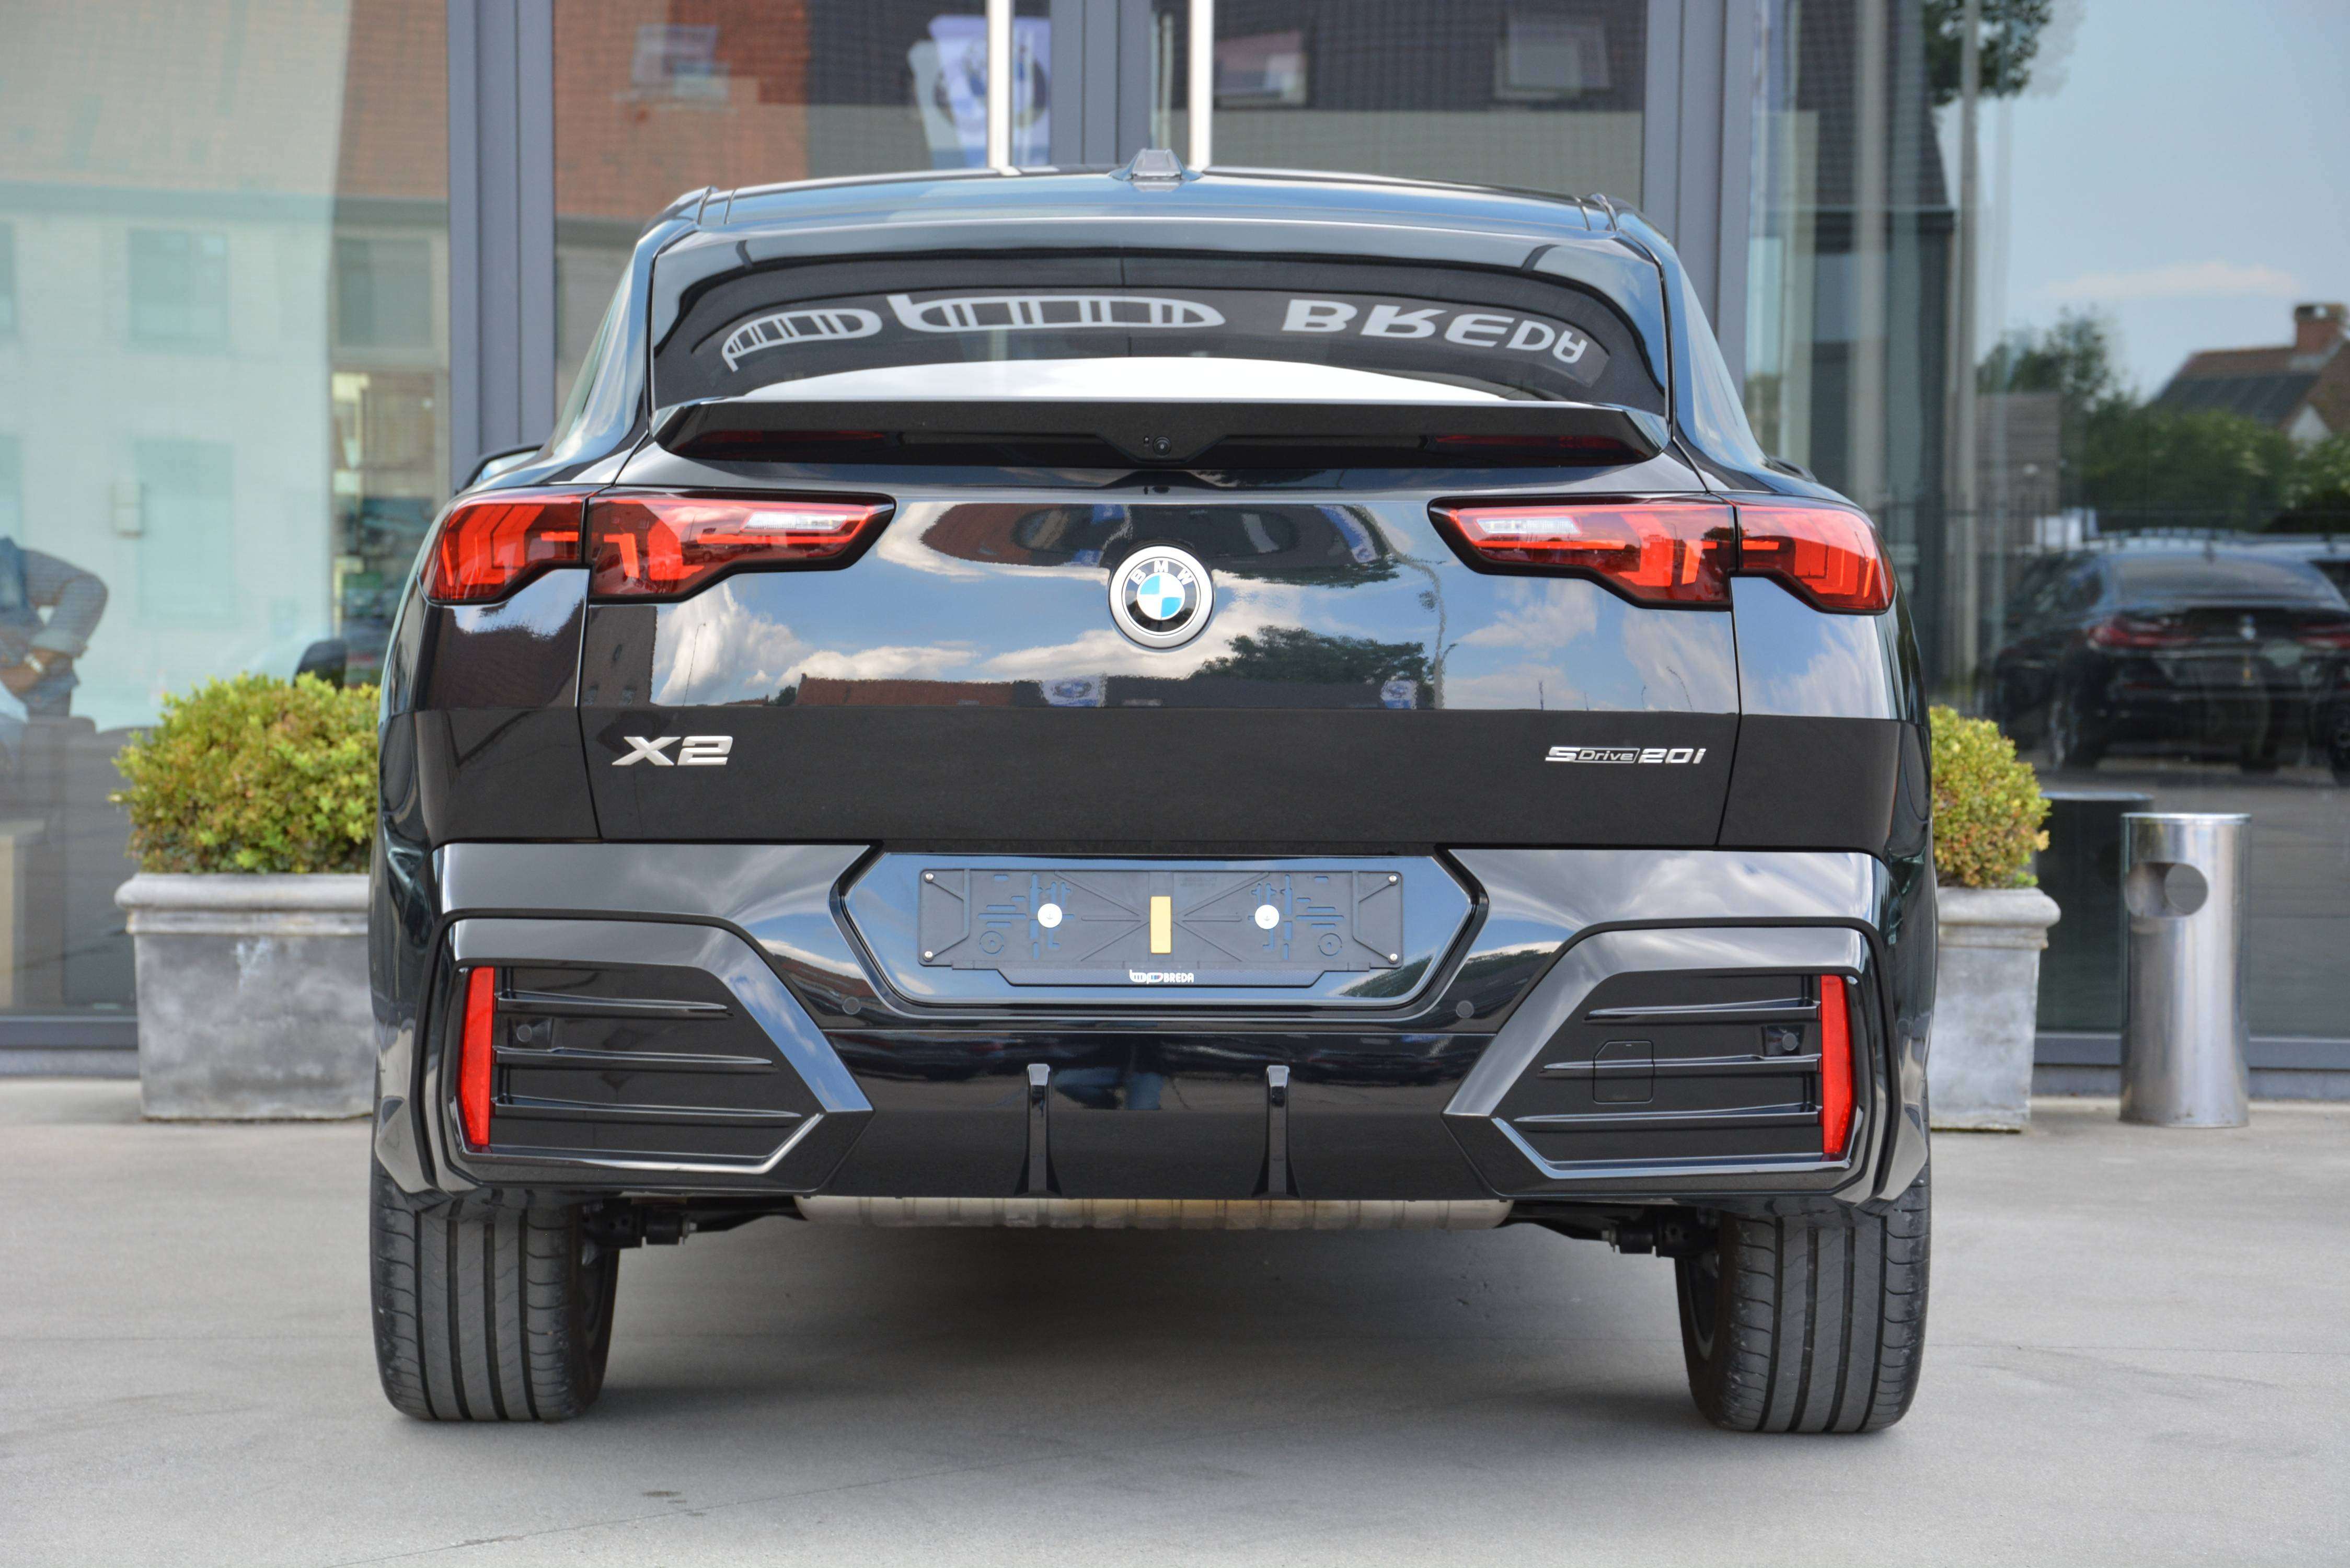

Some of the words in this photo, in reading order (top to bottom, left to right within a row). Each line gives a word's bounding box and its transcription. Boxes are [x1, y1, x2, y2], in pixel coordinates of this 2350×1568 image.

[1130, 560, 1193, 585] BMW
[612, 735, 733, 766] X2
[1163, 972, 1194, 983] BREDA
